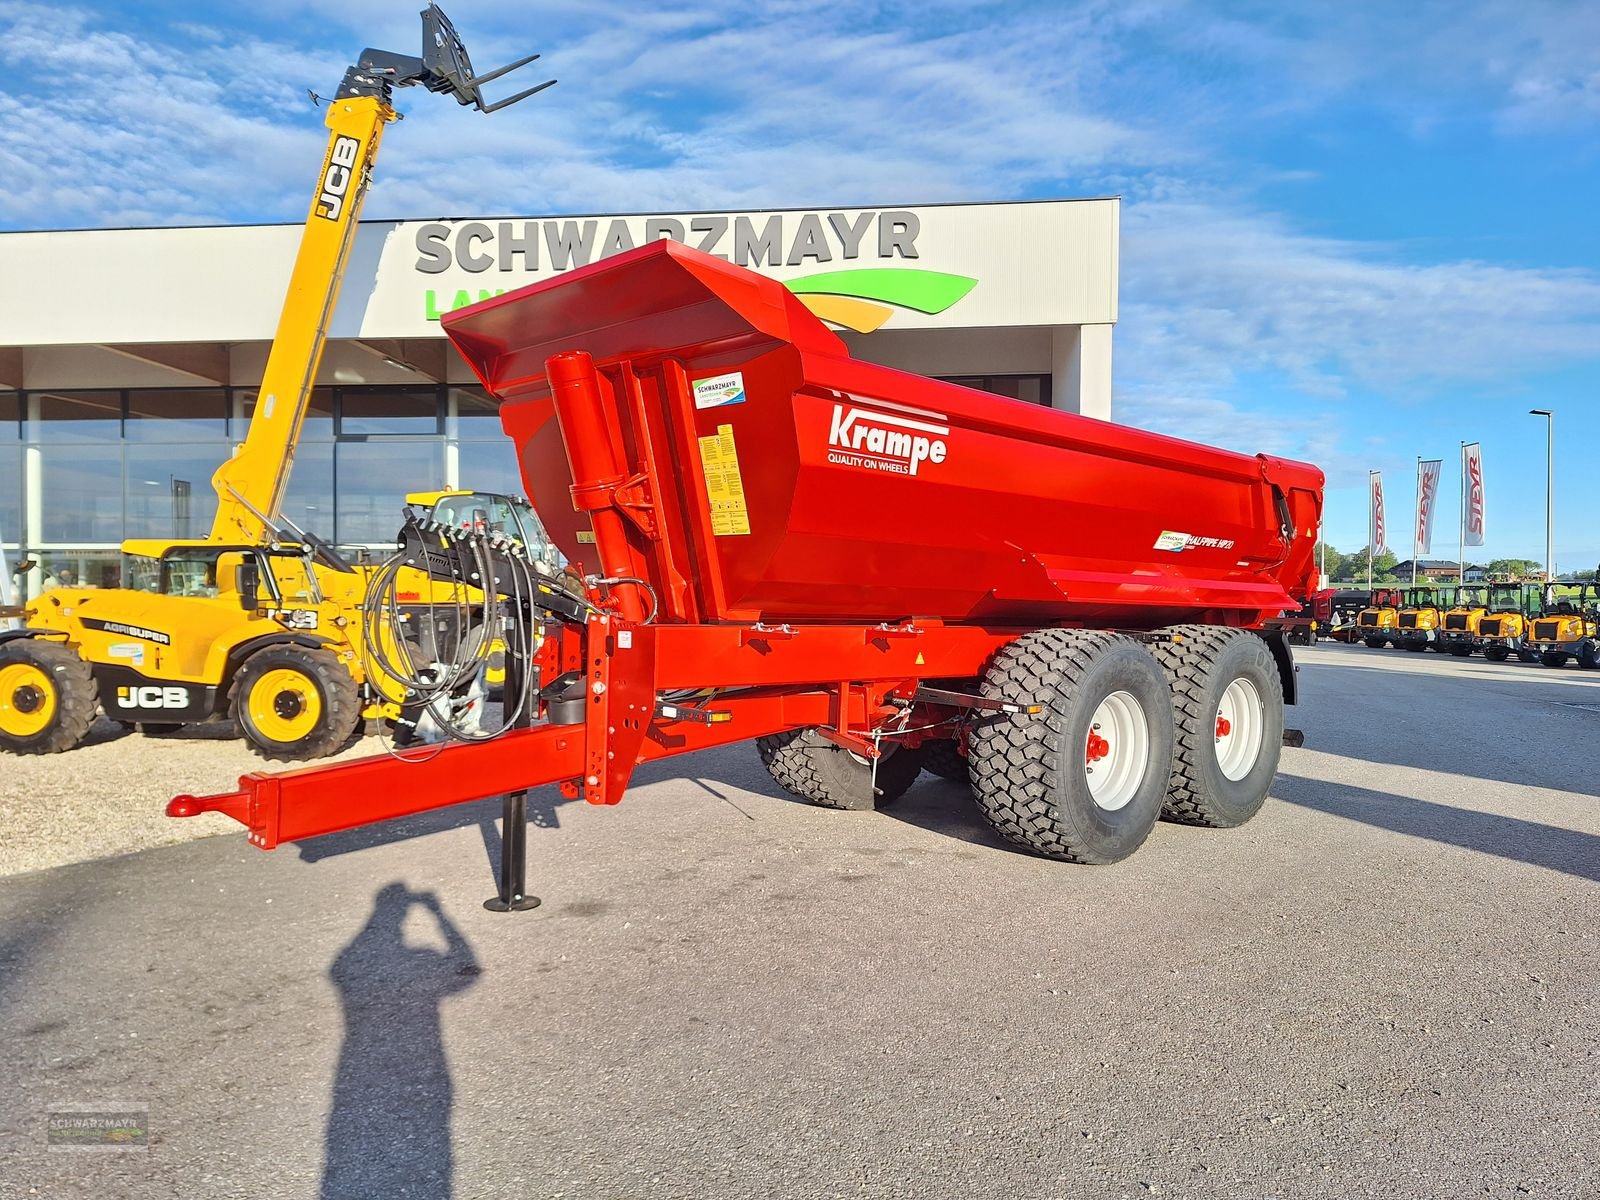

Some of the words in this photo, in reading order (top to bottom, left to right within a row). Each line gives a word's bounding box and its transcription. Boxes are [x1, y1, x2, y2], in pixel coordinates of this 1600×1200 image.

[316, 137, 358, 219] JCB
[697, 381, 736, 393] SCHWARZMAYR
[828, 404, 949, 476] Krampe
[828, 453, 862, 467] QUALITY
[864, 459, 878, 470] ON
[878, 462, 909, 475] WHEELS
[1374, 481, 1384, 547] STEYR
[1418, 472, 1433, 545] STEYR
[1469, 456, 1482, 535] STEYR
[117, 686, 189, 709] JCB
